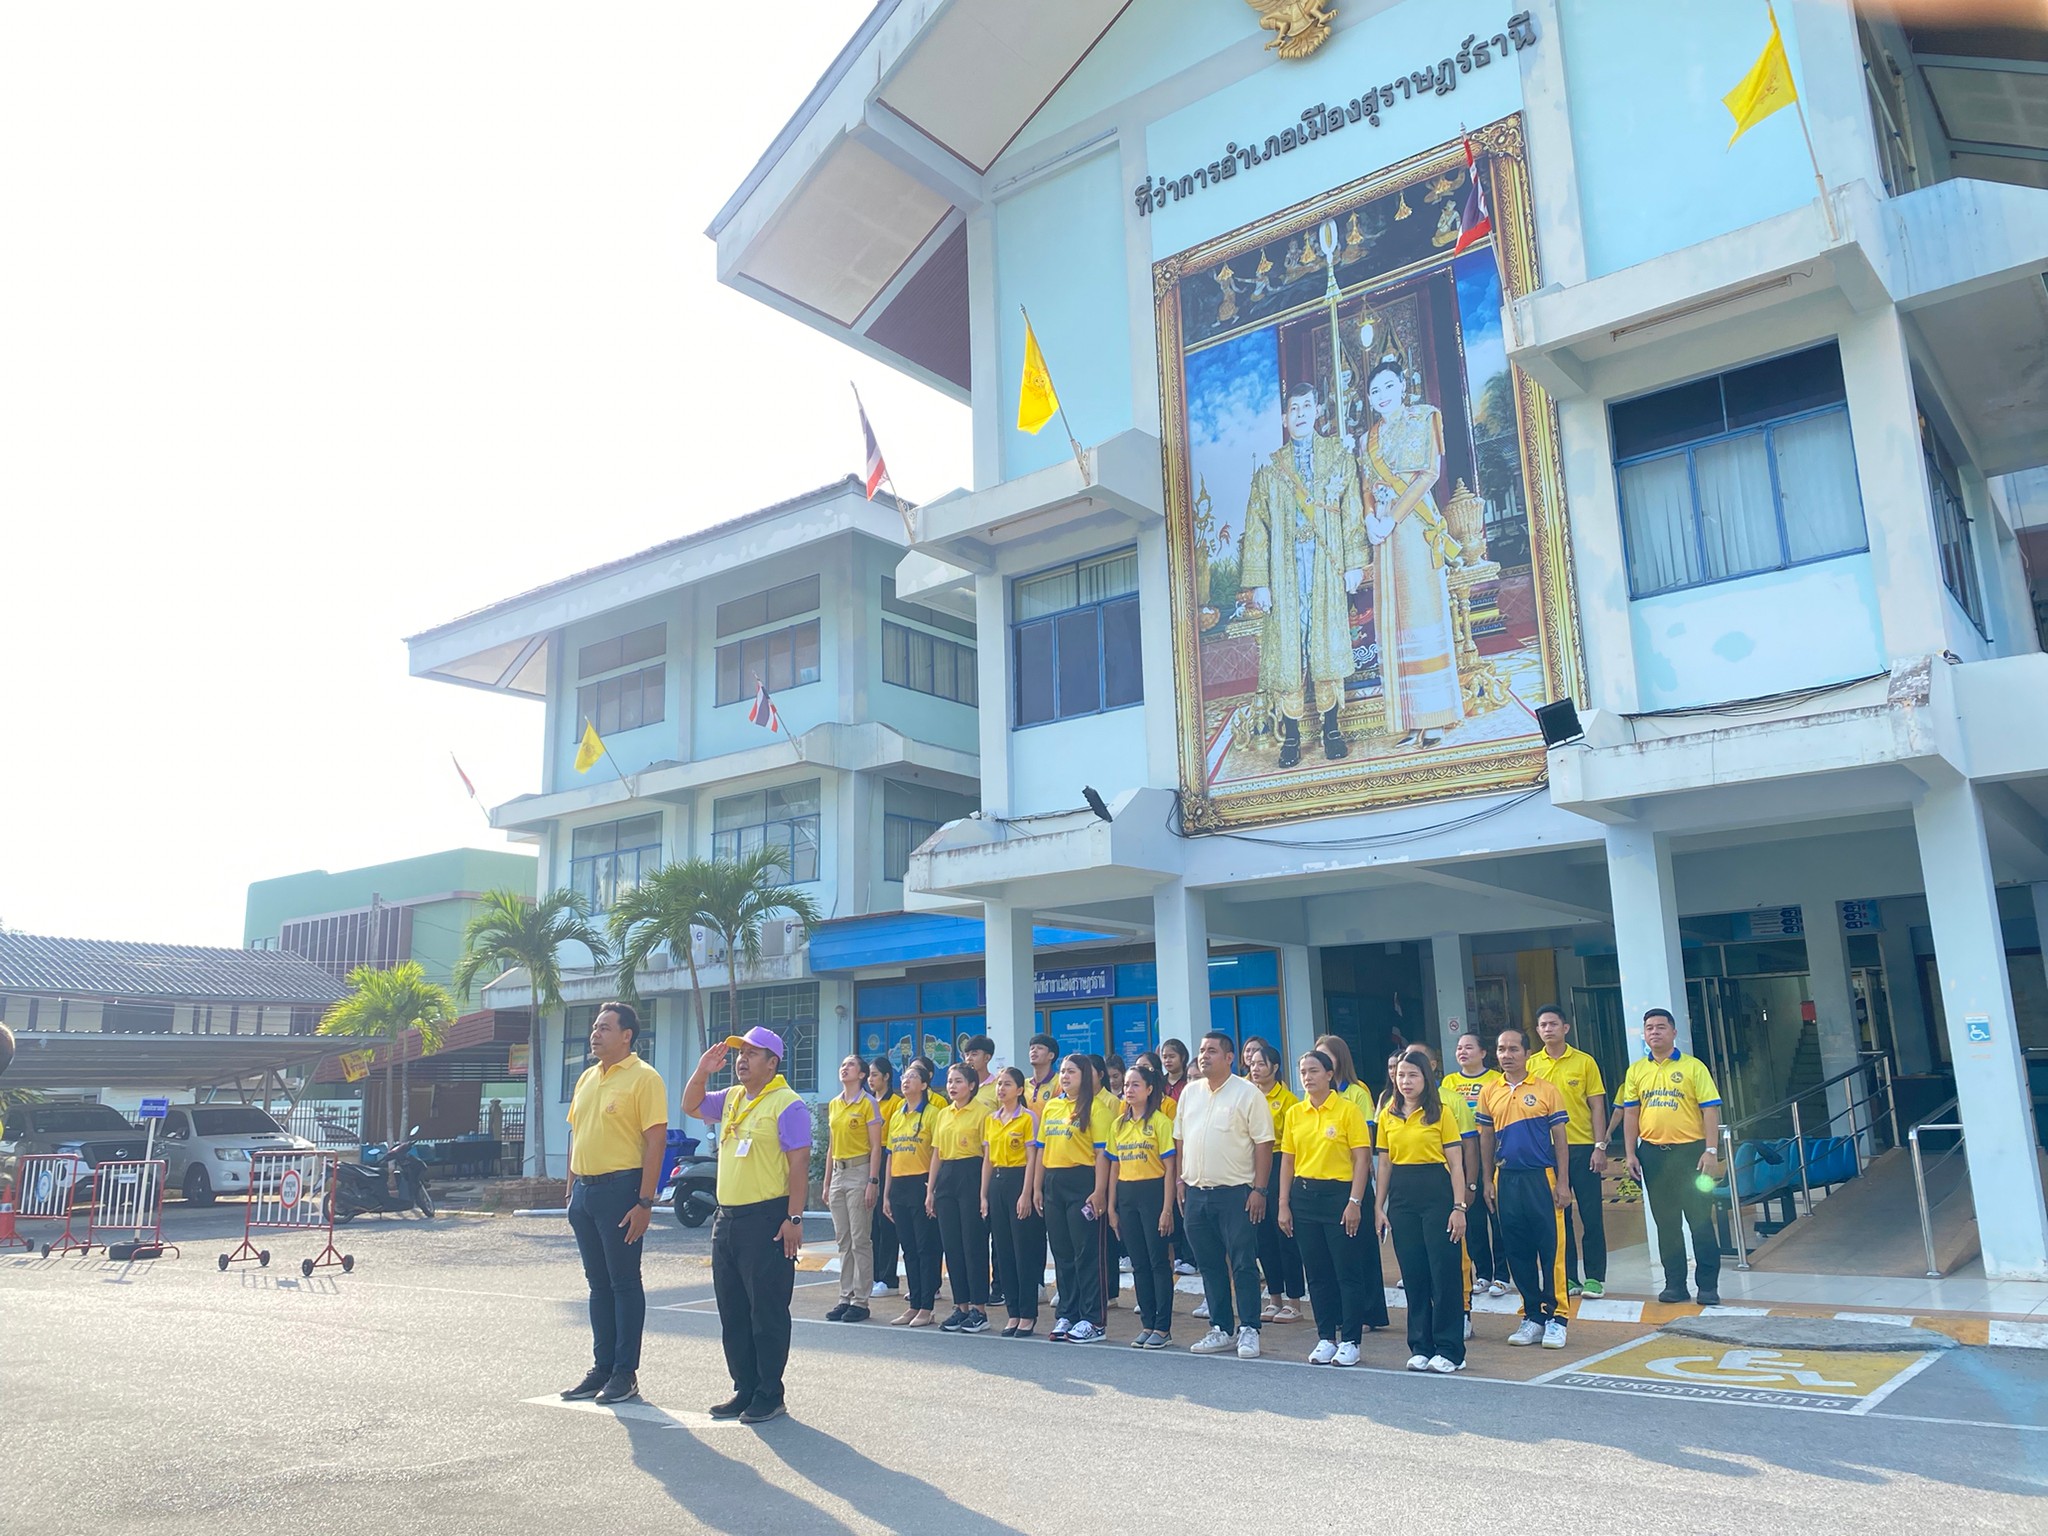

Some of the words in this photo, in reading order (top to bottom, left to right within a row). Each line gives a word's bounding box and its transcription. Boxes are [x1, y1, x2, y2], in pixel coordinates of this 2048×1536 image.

[1134, 9, 1537, 217] ที่ว่าการอำเภอเมืองสุราษฎร์ธานี
